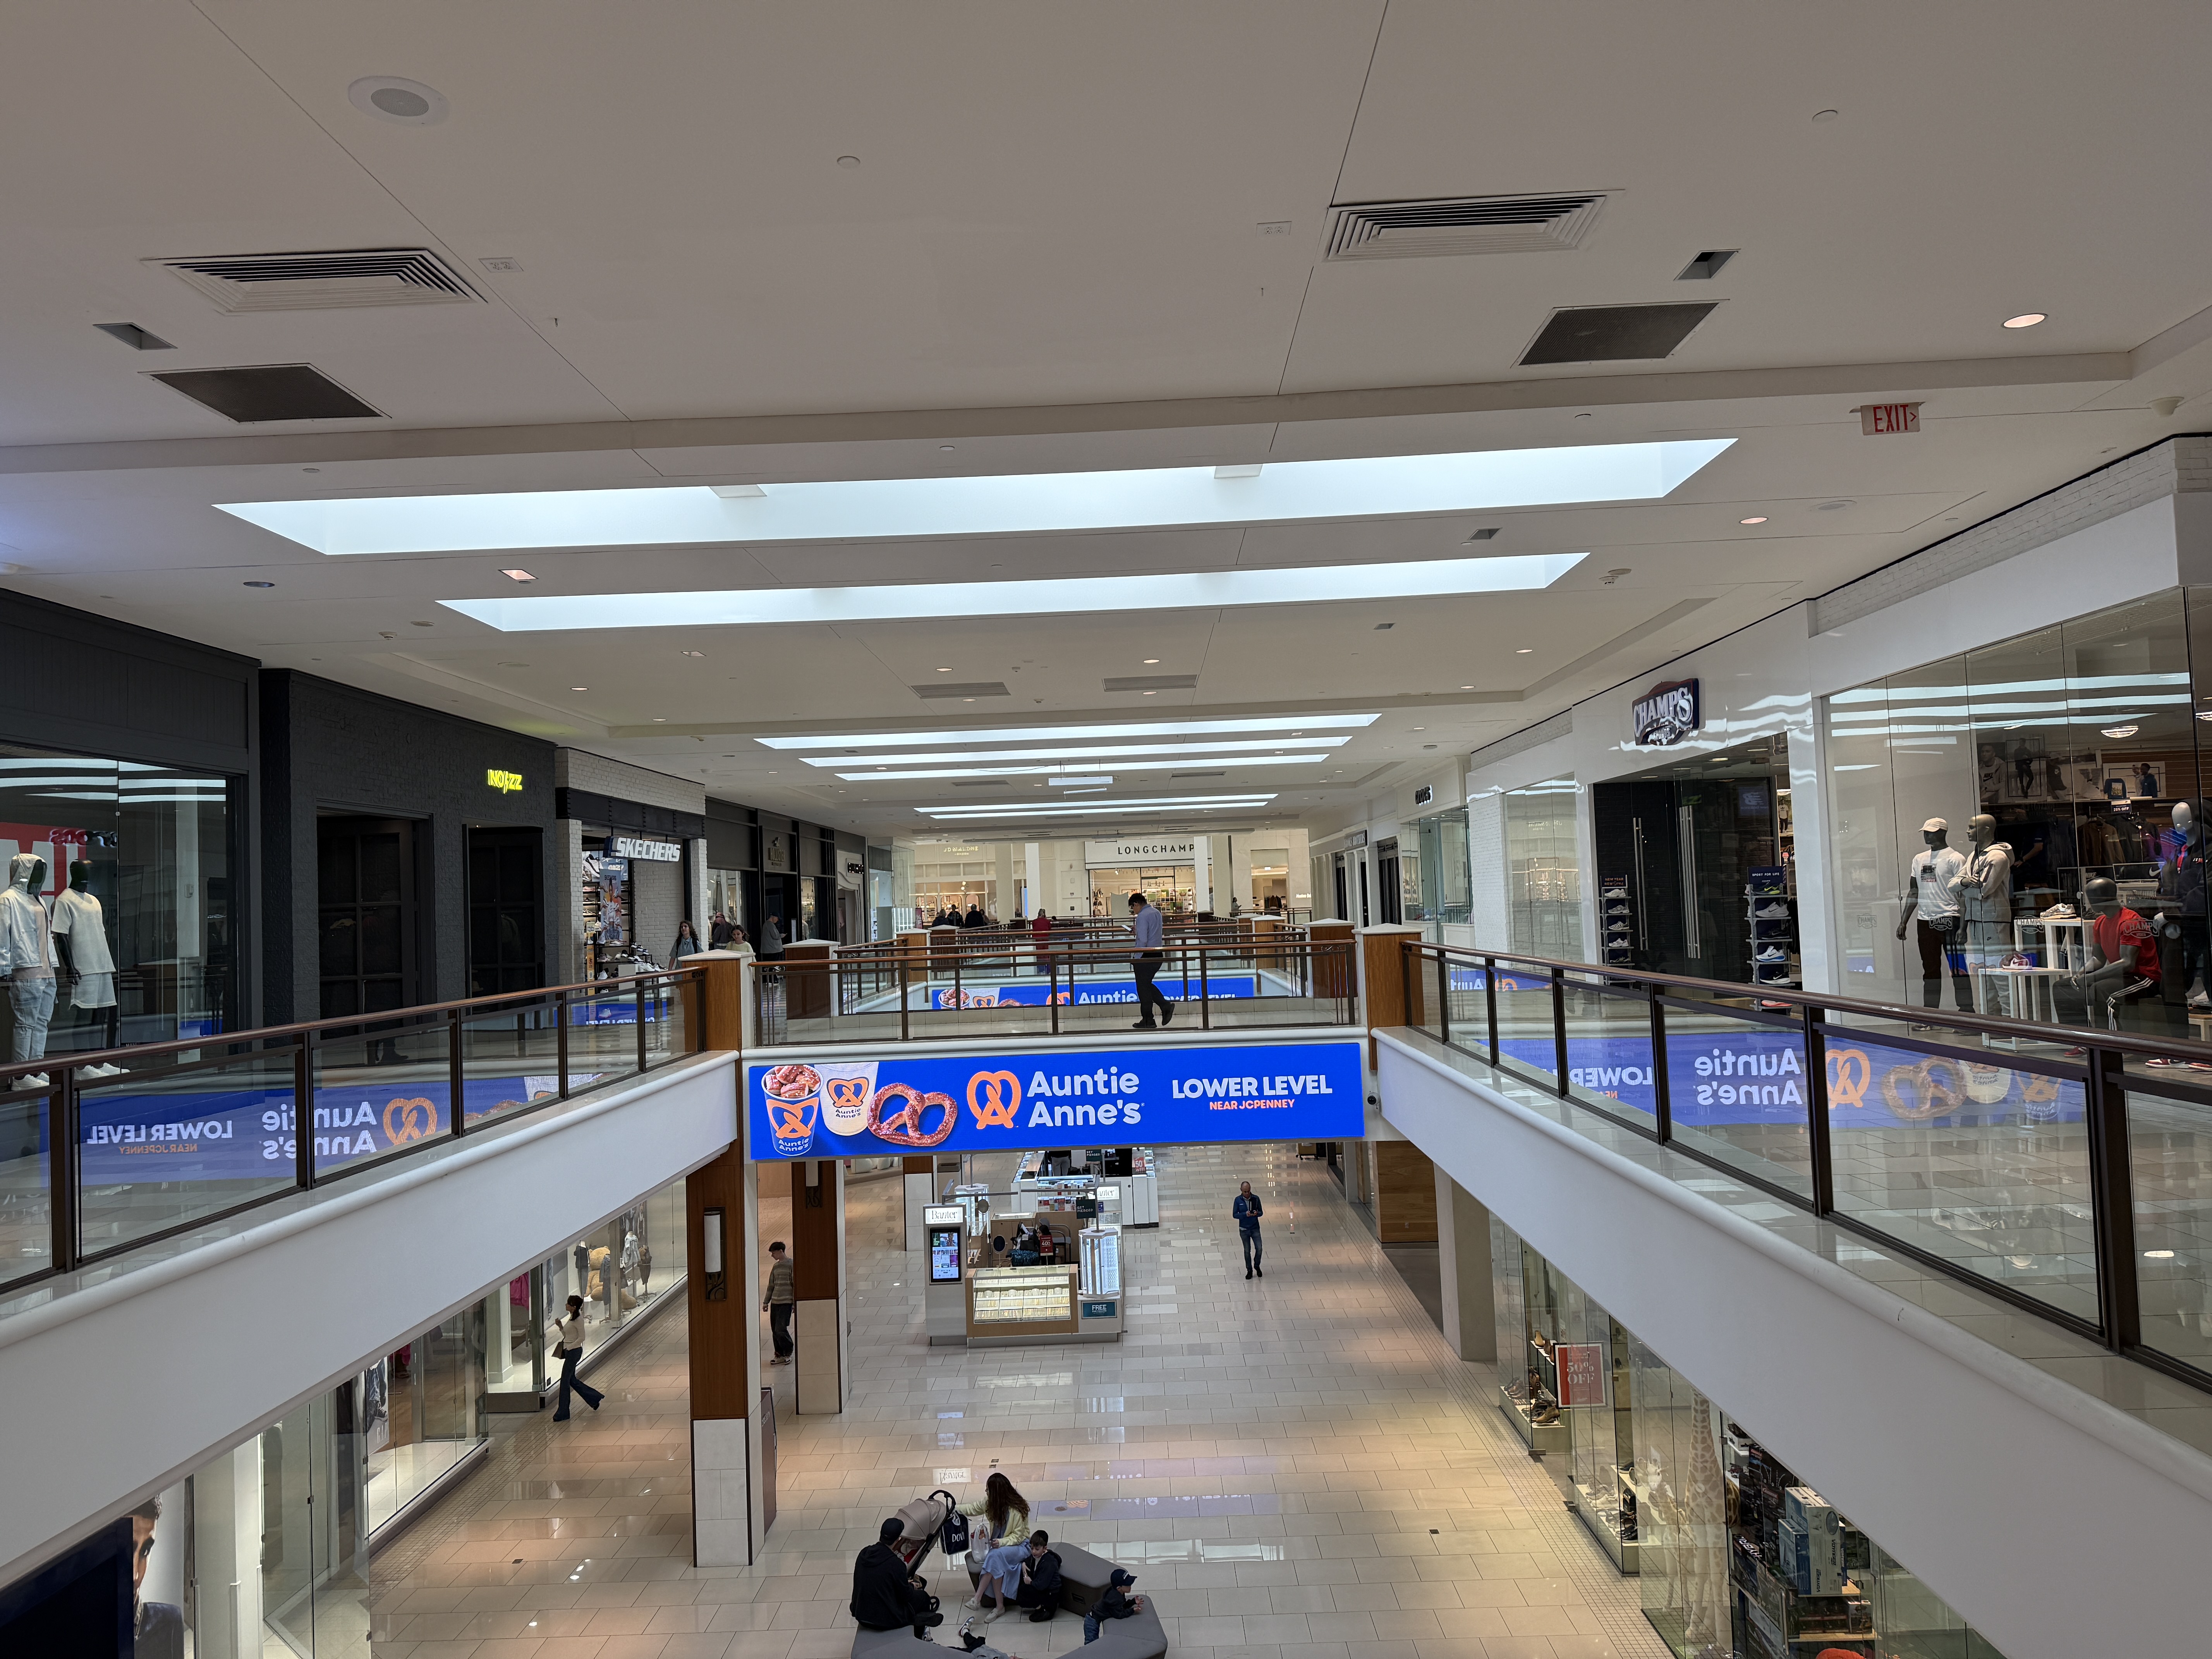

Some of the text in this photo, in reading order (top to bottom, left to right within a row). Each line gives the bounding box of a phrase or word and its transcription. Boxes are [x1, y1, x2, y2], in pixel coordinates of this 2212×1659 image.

[1873, 404, 1909, 433] EXIT
[1633, 687, 1691, 737] CHAMPS
[1653, 727, 1672, 740] SPORTS
[1415, 785, 1432, 805] crocs
[616, 837, 680, 862] SKECHERS
[1118, 844, 1194, 854] LONGCHAMP
[1858, 916, 1877, 925] CHAMPS
[1930, 917, 1952, 928] CHAMPS
[2016, 918, 2044, 929] CHAMPS
[2123, 921, 2159, 936] CHAMPS
[1078, 990, 1138, 1004] Auntie
[1027, 1066, 1139, 1097] Auntie
[1172, 1075, 1333, 1099] LOWER LEVEL
[1209, 1099, 1295, 1110] NEAR JCPENNEY
[1028, 1099, 1141, 1127] Anne's
[778, 1138, 809, 1147] Auntie
[779, 1143, 809, 1152] Anne's
[932, 1210, 957, 1219] Banter
[1567, 1362, 1594, 1372] 50%
[1567, 1373, 1595, 1384] OFF
